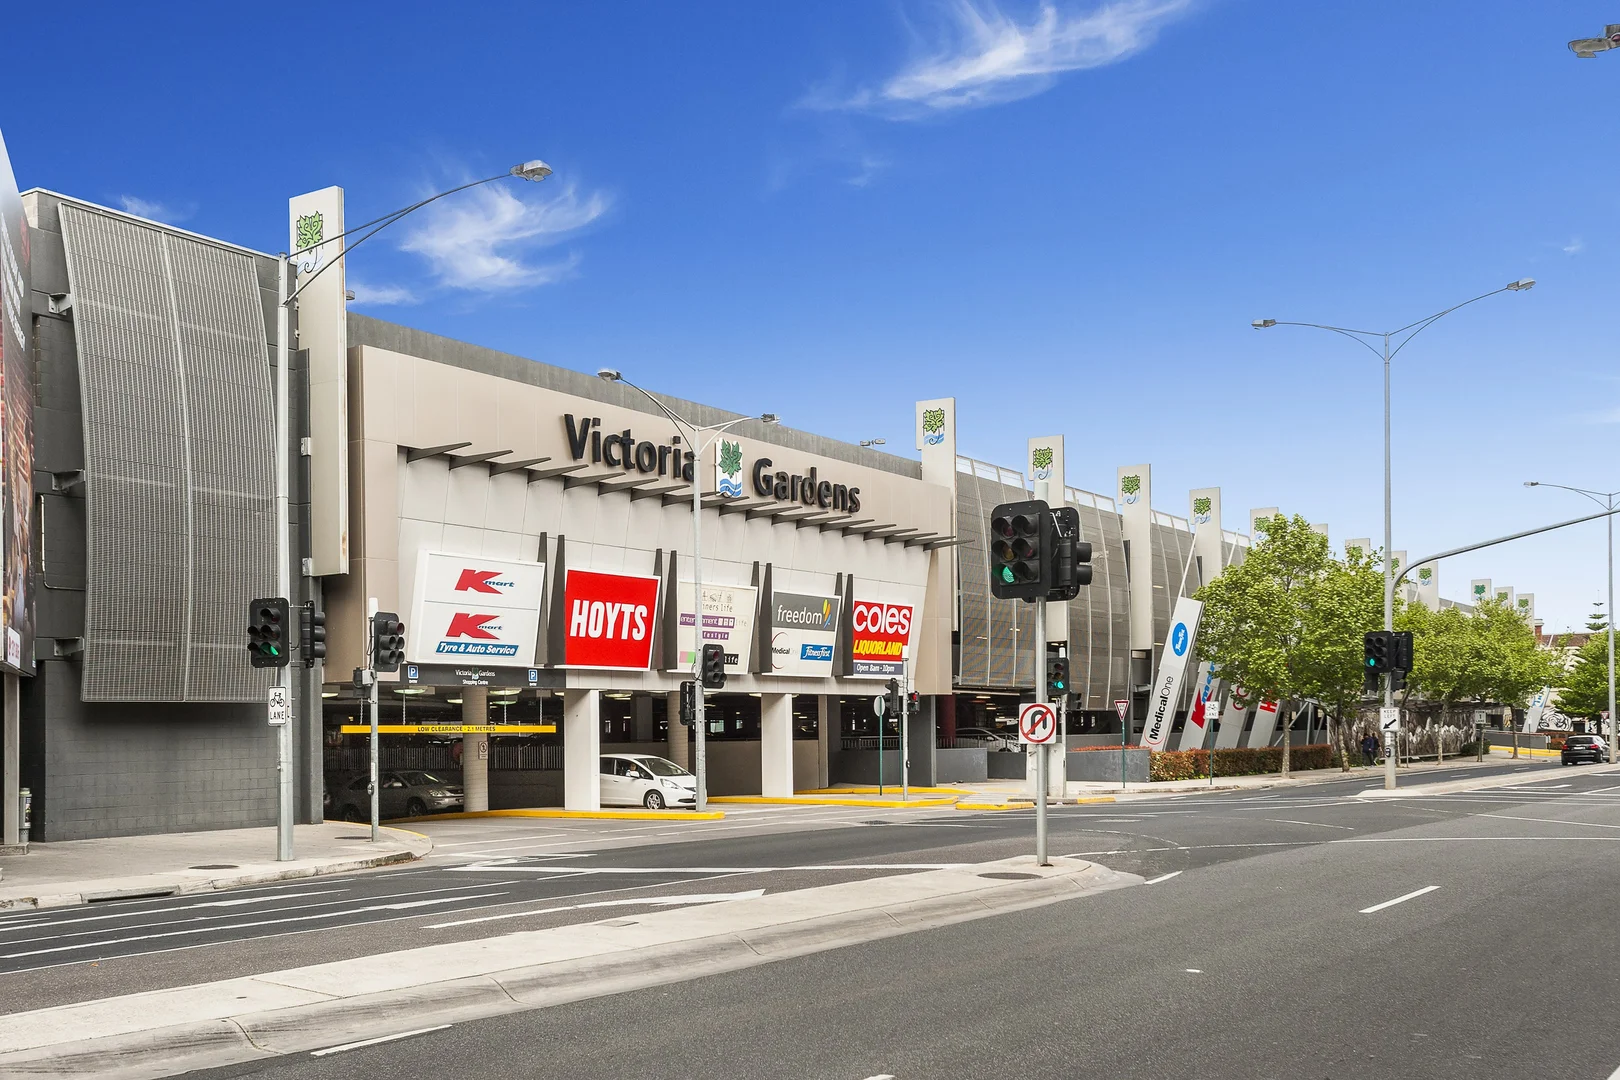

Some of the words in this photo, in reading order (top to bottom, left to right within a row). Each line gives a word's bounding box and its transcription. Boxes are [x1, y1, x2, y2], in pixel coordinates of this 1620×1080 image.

[564, 413, 696, 482] Victoria
[753, 457, 861, 514] Gardens
[455, 569, 515, 595] Kmart
[702, 603, 719, 611] iners
[777, 605, 823, 625] freedom
[446, 612, 503, 640] Kmart
[570, 599, 648, 641] HOYTS
[853, 604, 910, 635] coles
[439, 643, 458, 653] Tyre
[458, 644, 466, 652] &
[466, 645, 486, 653] Auto
[486, 646, 516, 655] Service
[853, 640, 903, 656] LIQUORLAND
[478, 669, 496, 677] Gardens
[856, 664, 869, 673] Open
[869, 664, 880, 672] 8am
[882, 665, 895, 673] 10pm
[270, 711, 285, 720] LANE
[1149, 675, 1174, 740] MedicalOne
